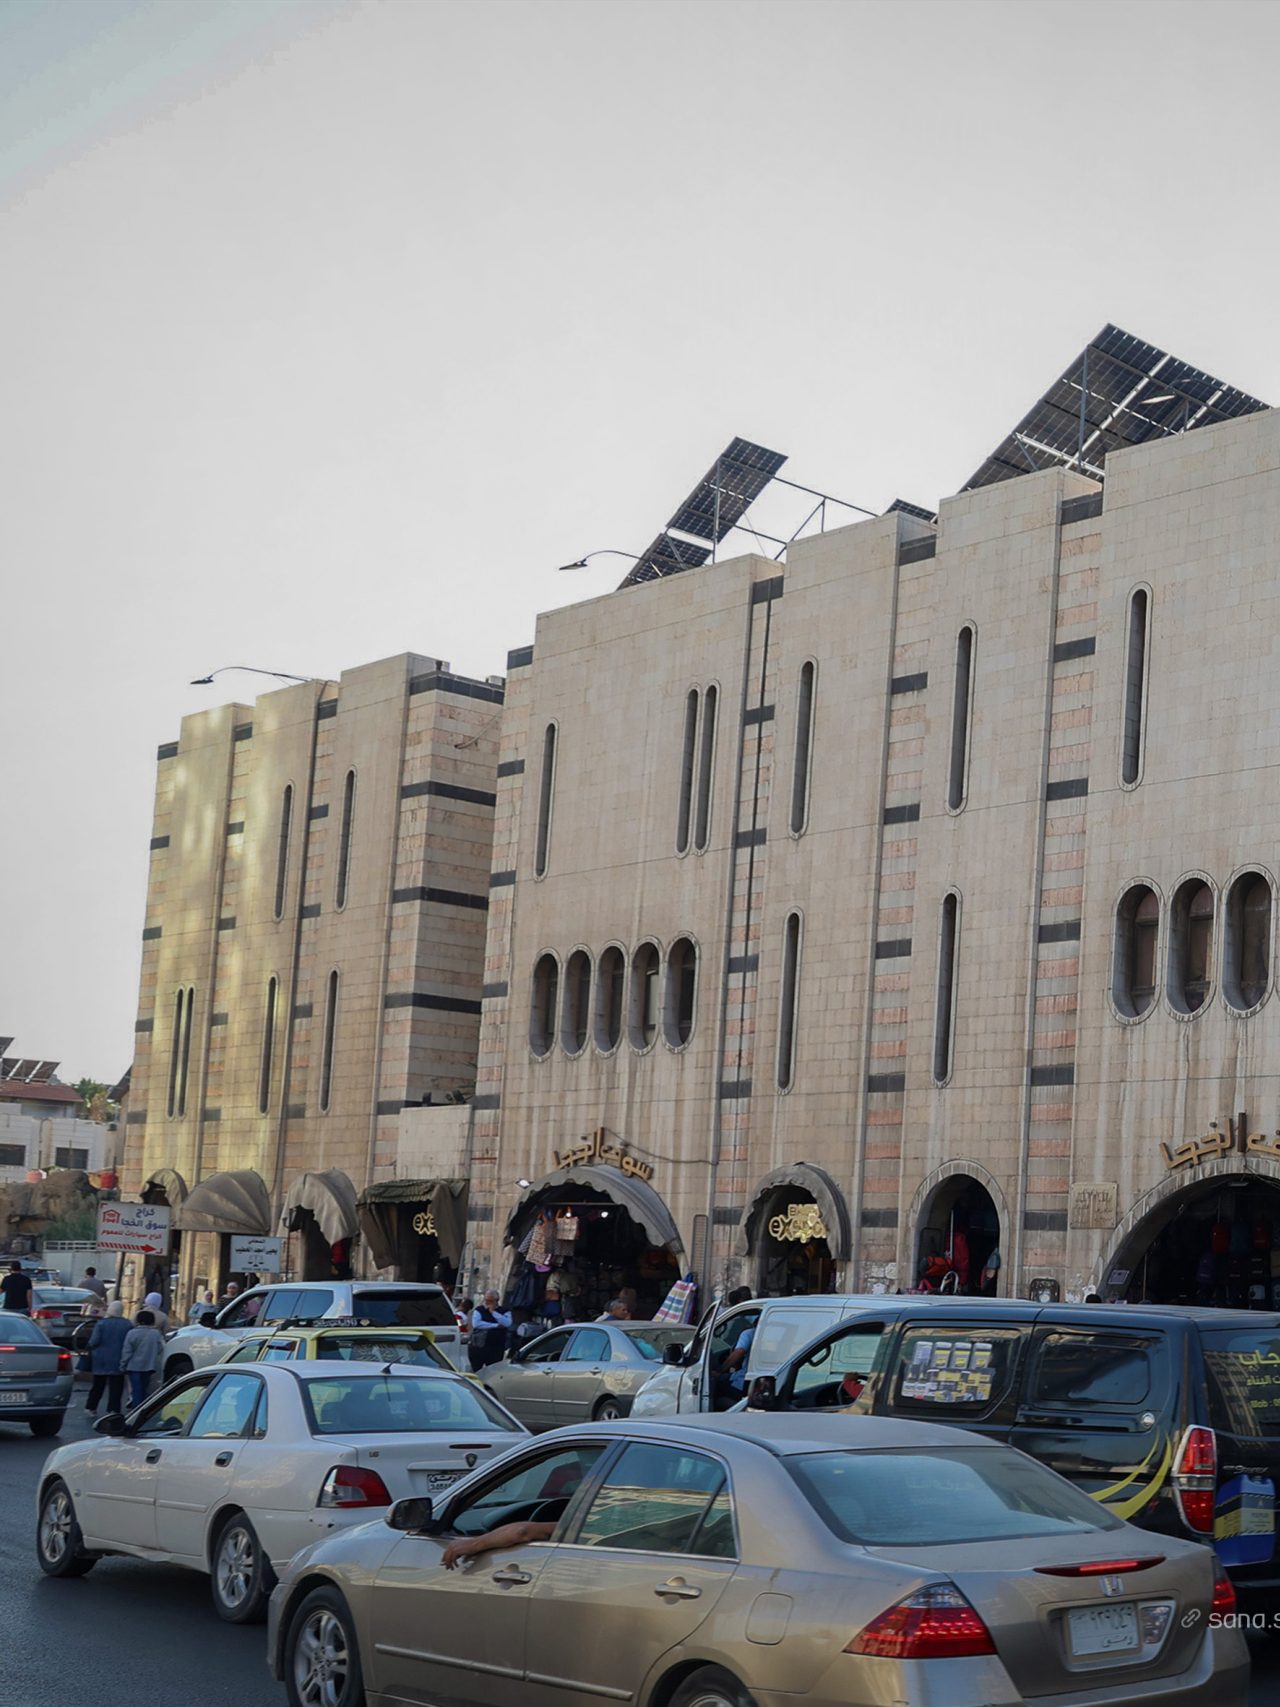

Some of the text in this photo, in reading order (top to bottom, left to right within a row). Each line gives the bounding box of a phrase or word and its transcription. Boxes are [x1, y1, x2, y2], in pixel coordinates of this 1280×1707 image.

[553, 1126, 654, 1180] سوق الخجا
[1159, 1111, 1248, 1169] الخجا
[120, 1217, 167, 1230] سوق الخجا
[135, 1207, 156, 1218] كراج
